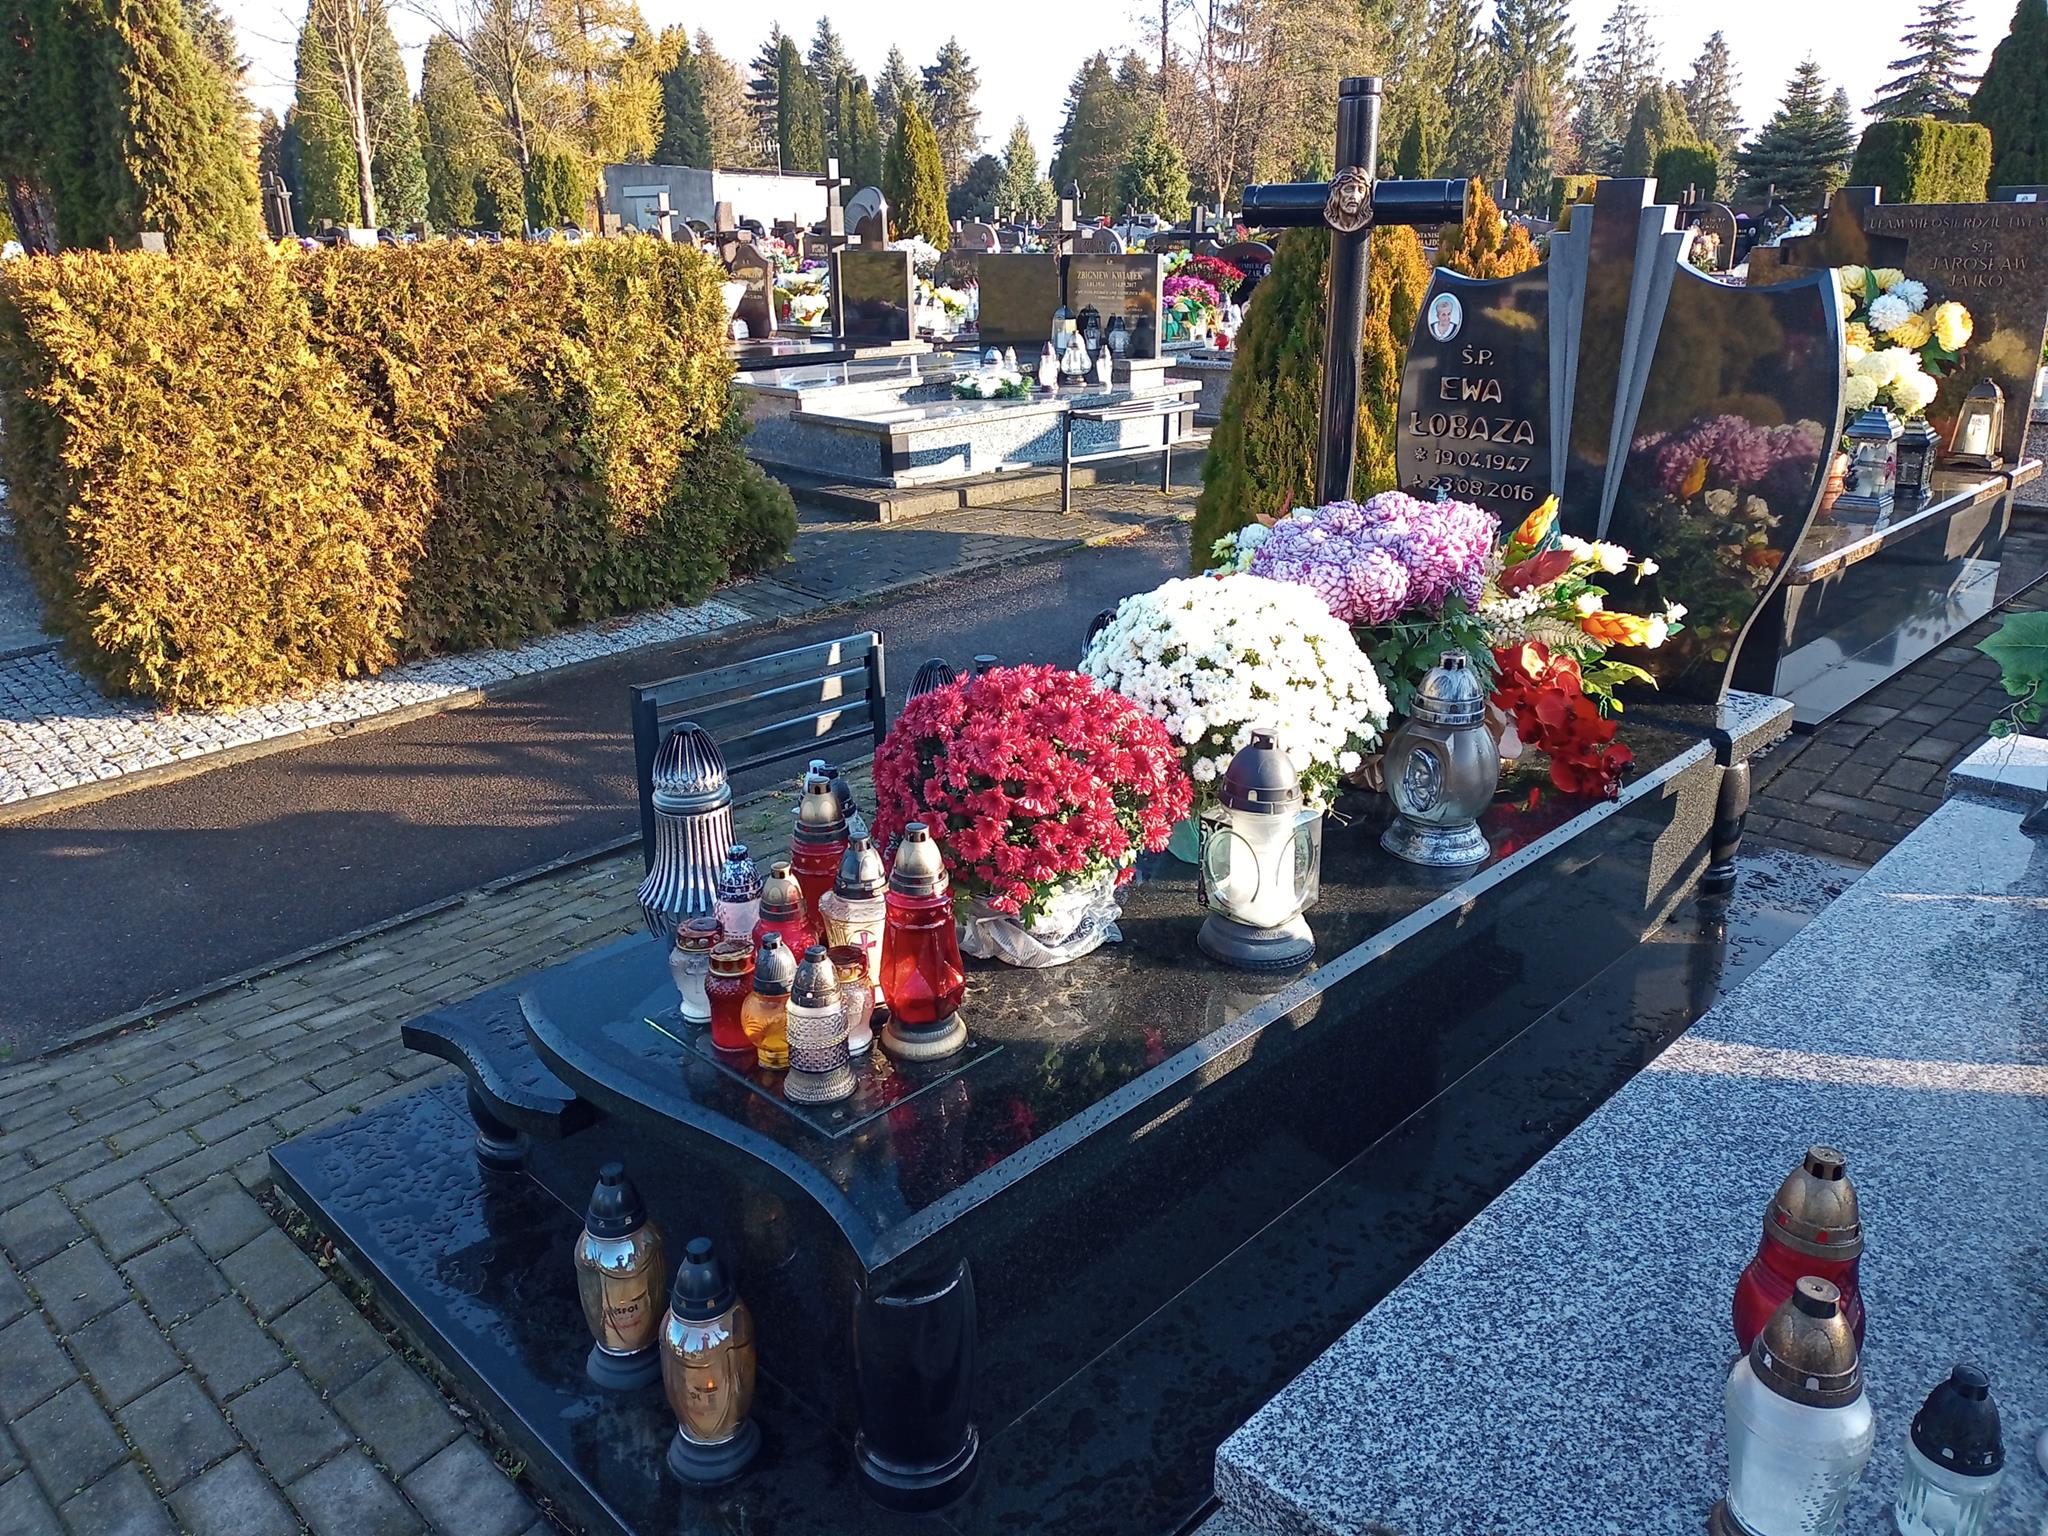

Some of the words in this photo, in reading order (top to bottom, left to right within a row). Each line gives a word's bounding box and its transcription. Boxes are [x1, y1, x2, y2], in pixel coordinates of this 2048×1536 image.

[1076, 270, 1110, 281] ZBIGNIEW
[1111, 271, 1143, 281] KWIATEK
[1461, 344, 1495, 366] Ś.P.
[1441, 376, 1501, 403] EWA
[1409, 412, 1534, 444] ŁOBAZA
[1436, 449, 1530, 472] 19.04.1947
[1429, 477, 1533, 501] 23.08.2016
